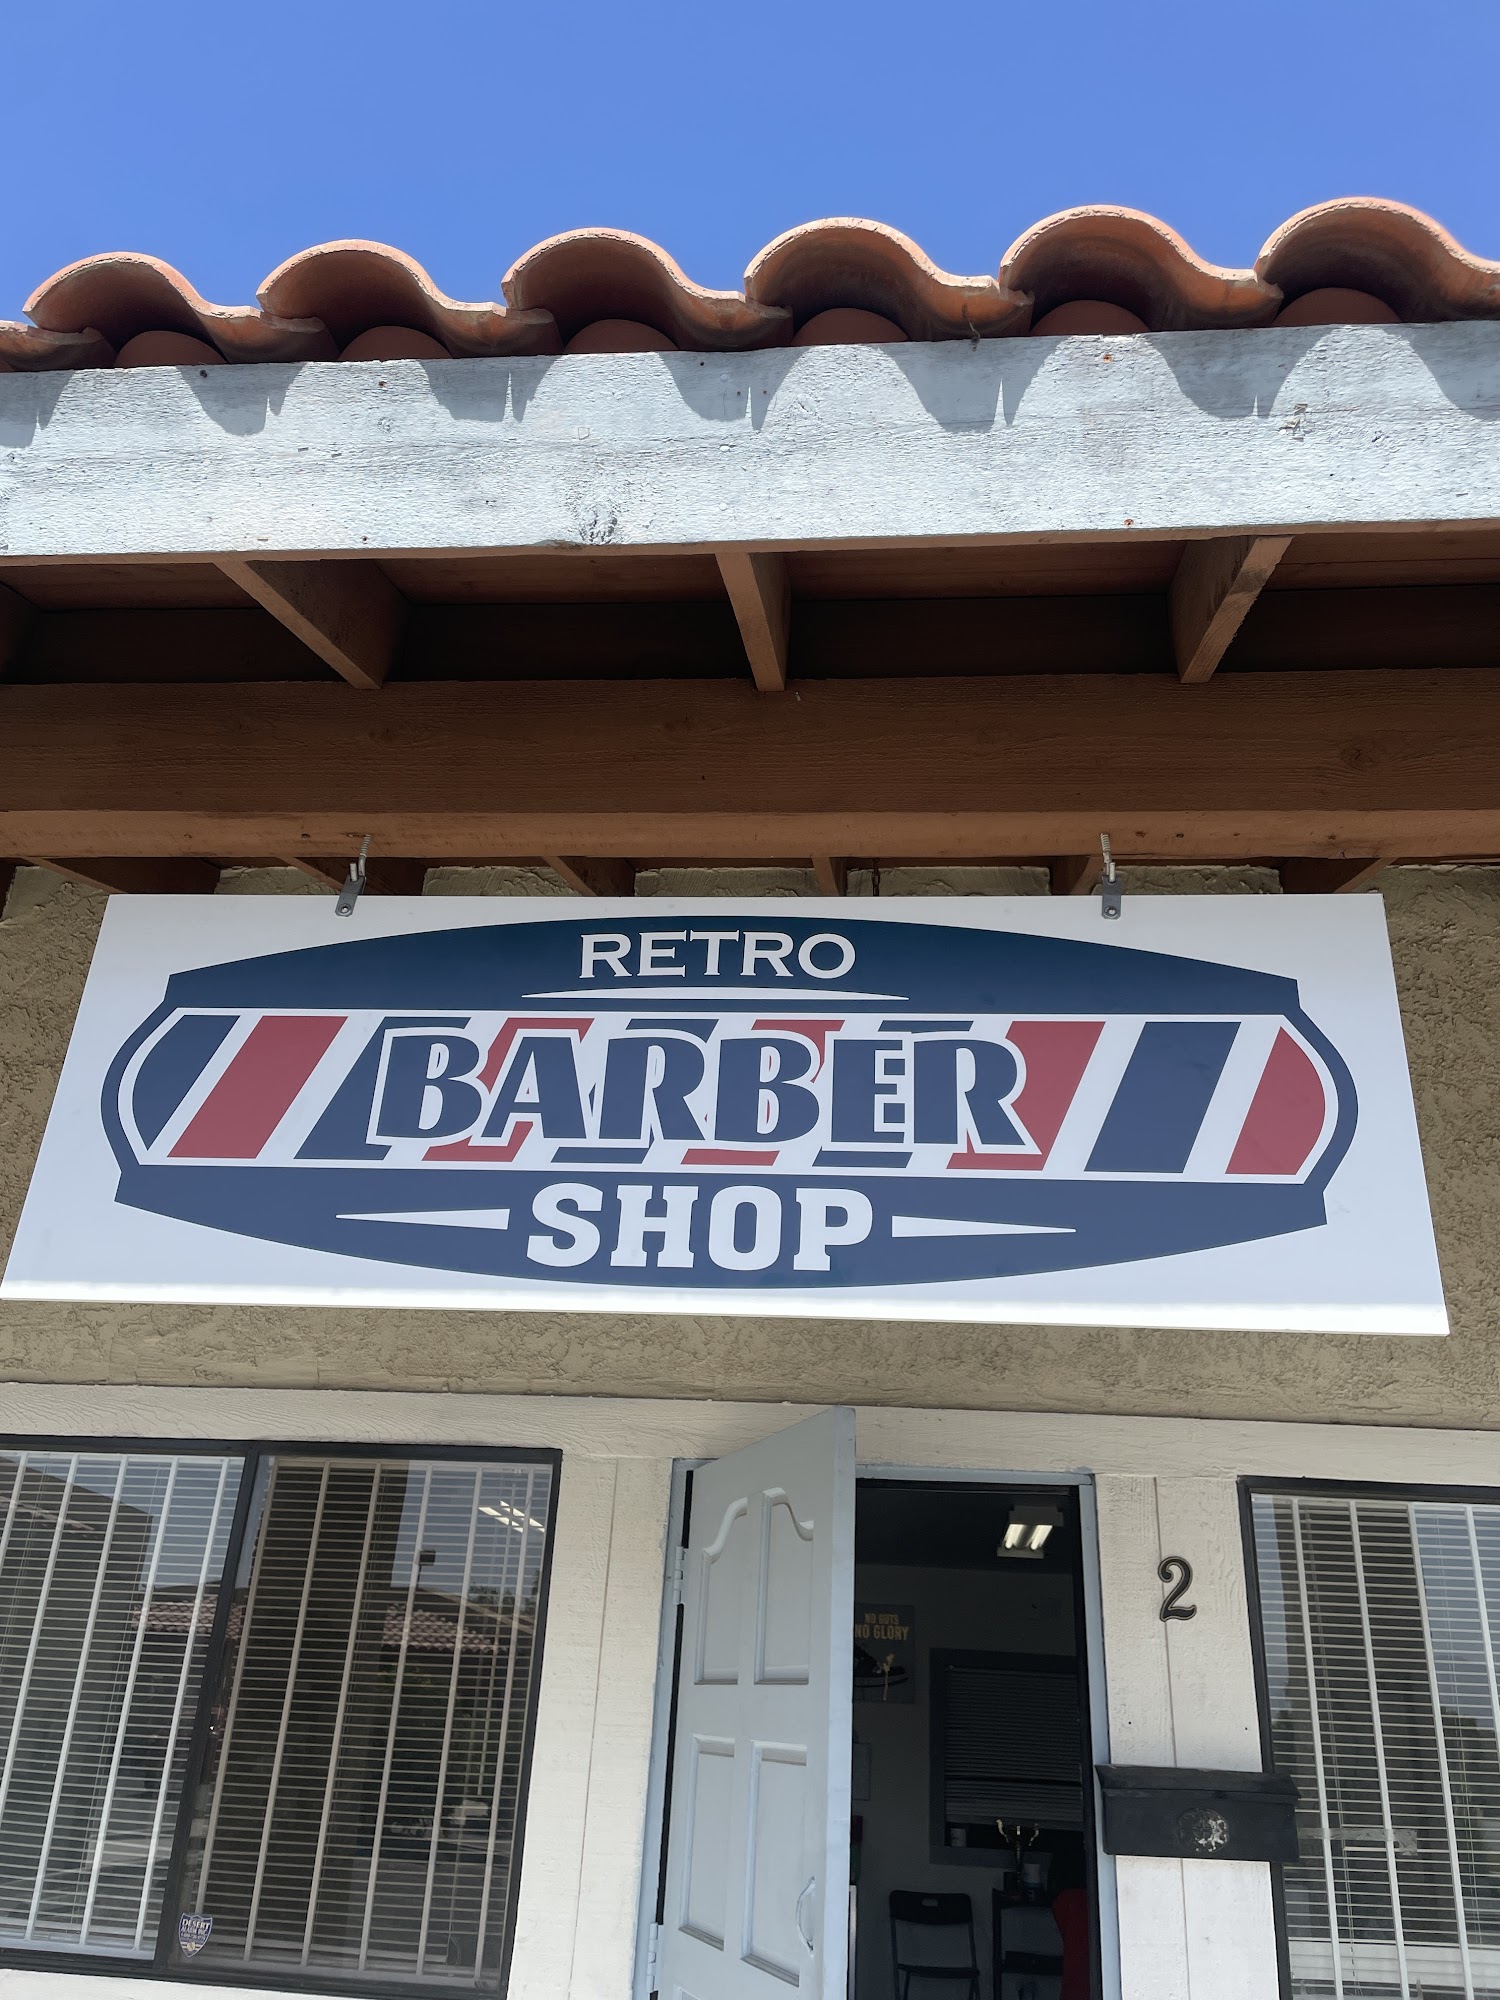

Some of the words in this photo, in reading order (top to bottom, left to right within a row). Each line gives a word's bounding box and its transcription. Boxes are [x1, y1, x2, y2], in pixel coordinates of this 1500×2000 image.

[579, 930, 856, 980] RETRO
[370, 1027, 1040, 1152] BARBER
[526, 1182, 873, 1273] SHOP
[1157, 1555, 1197, 1622] 2
[855, 1624, 870, 1639] NO
[873, 1625, 909, 1641] GLORY
[182, 1919, 210, 1929] DESERT
